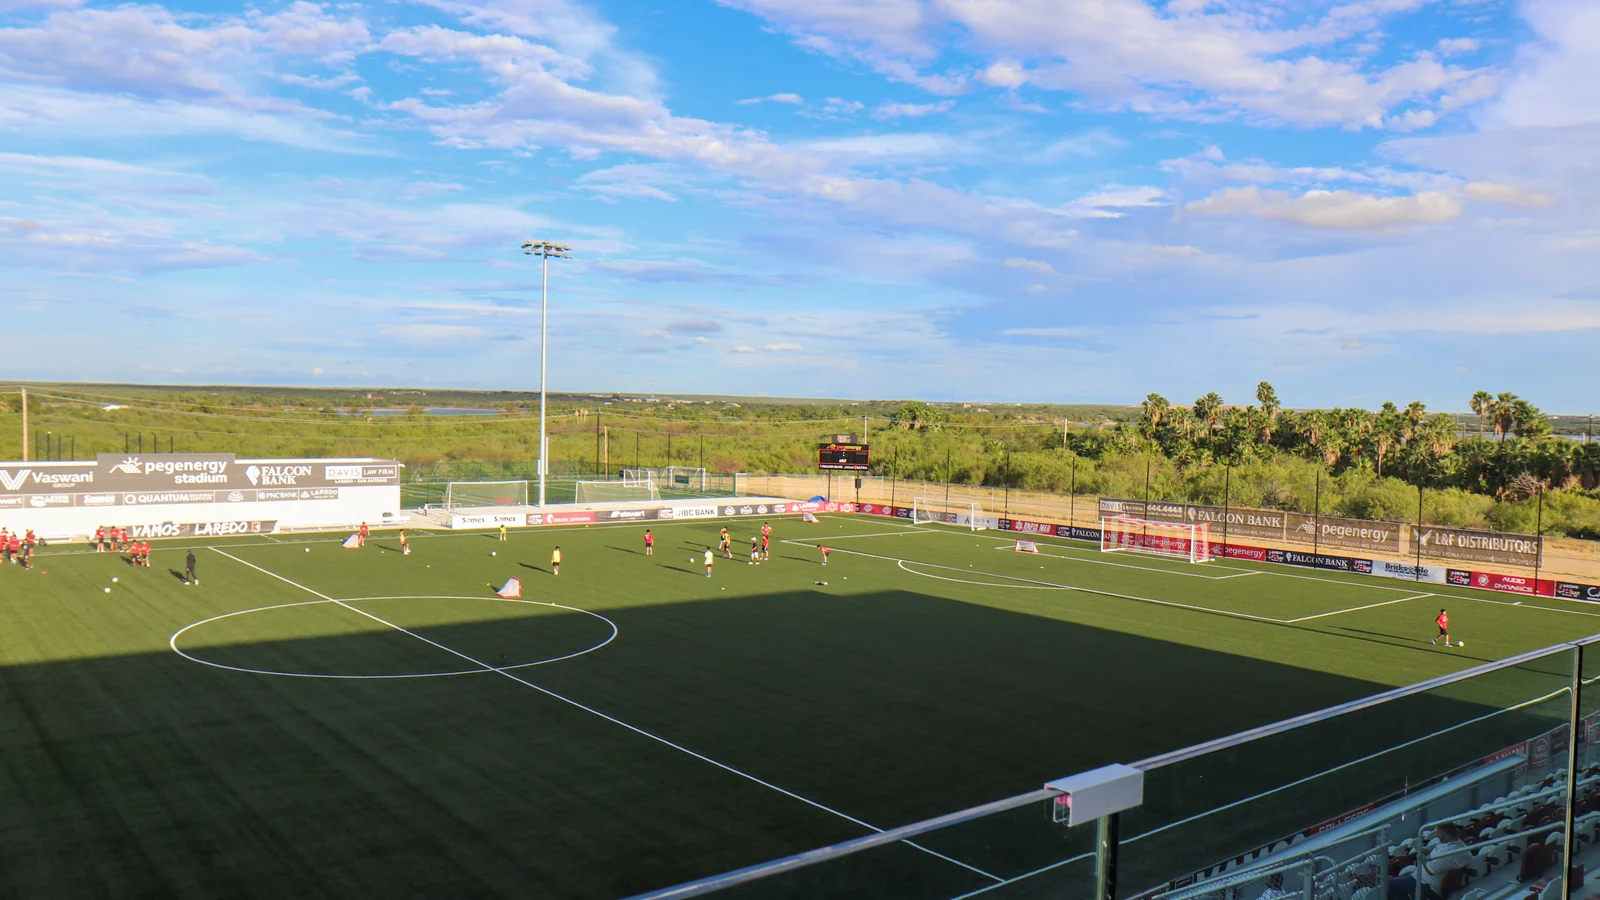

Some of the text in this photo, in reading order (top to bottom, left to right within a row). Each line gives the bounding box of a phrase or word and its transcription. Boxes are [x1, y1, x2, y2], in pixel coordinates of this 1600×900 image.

[145, 461, 227, 475] pegenergy
[261, 466, 312, 476] FALCON
[328, 468, 360, 477] DAVIS
[31, 471, 94, 484] Vaswani
[174, 472, 227, 484] stadium
[261, 476, 297, 485] BANK
[138, 493, 190, 503] QUANTUM
[310, 489, 338, 498] LAREDO
[1101, 501, 1121, 510] DAVIS
[695, 508, 715, 516] BANK
[1197, 510, 1244, 524] FALCON
[1247, 514, 1282, 528] BANK
[132, 523, 181, 538] VAMOS
[194, 521, 248, 536] LAREDO
[1076, 530, 1100, 538] FALCON
[1321, 524, 1389, 543] pegenergy
[1435, 532, 1538, 554] L&F DISTRIBUTORS
[1292, 554, 1324, 564] FALCON
[1325, 557, 1348, 567] BANK
